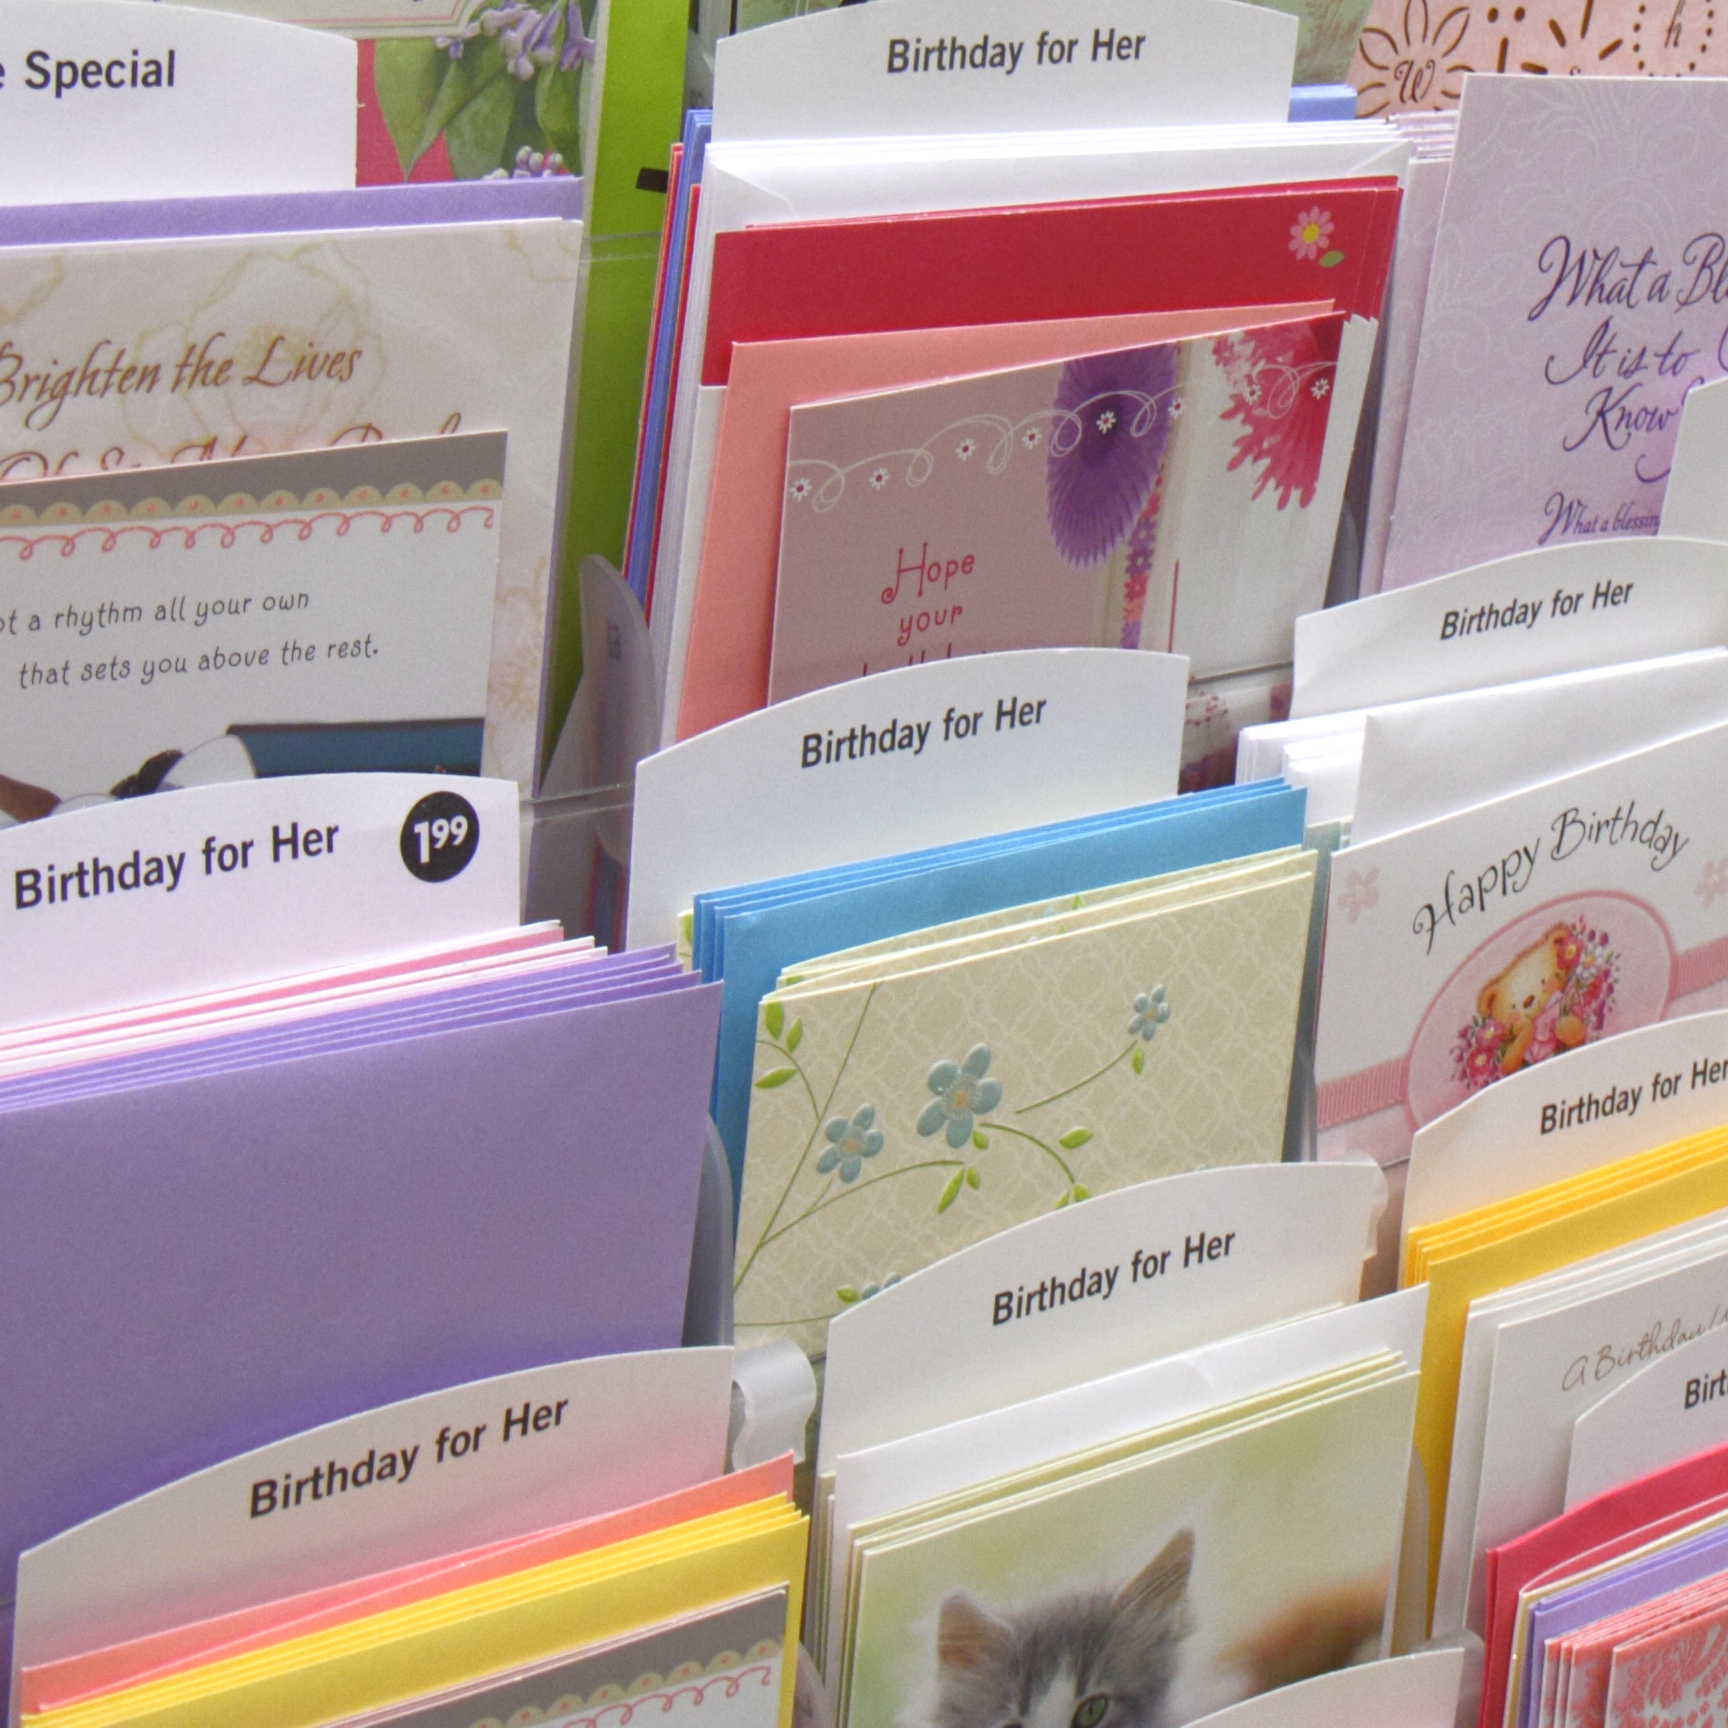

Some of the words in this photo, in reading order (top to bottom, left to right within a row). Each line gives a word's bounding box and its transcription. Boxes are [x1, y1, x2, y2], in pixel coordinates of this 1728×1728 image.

[25, 49, 177, 99] Special
[886, 33, 1024, 74] Birthday
[1036, 30, 1078, 65] for
[1090, 27, 1147, 62] Her
[28, 614, 42, 631] a
[54, 602, 144, 633] rhythm
[154, 596, 187, 624] all
[194, 599, 252, 626] your
[263, 591, 310, 614] own
[1439, 597, 1543, 641] Birthday
[1551, 588, 1584, 616] for
[1591, 579, 1633, 609] Her
[19, 660, 71, 689] that
[81, 655, 131, 682] sets
[142, 655, 189, 681] you
[199, 642, 270, 670] above
[281, 638, 317, 665] the
[327, 636, 379, 662] rest.
[801, 717, 931, 770] Birthday
[943, 707, 981, 741] for
[995, 697, 1047, 733] Her
[14, 844, 187, 910] Birthday
[202, 837, 256, 875] for
[271, 824, 340, 863] Her
[1411, 837, 1544, 955] Happy
[1550, 801, 1690, 872] Birthday
[991, 1262, 1120, 1328] Birthday
[1131, 1249, 1172, 1283] for
[1182, 1230, 1236, 1268] Her
[250, 1443, 421, 1519] Birthday
[434, 1424, 488, 1464] for
[501, 1396, 570, 1443] Her
